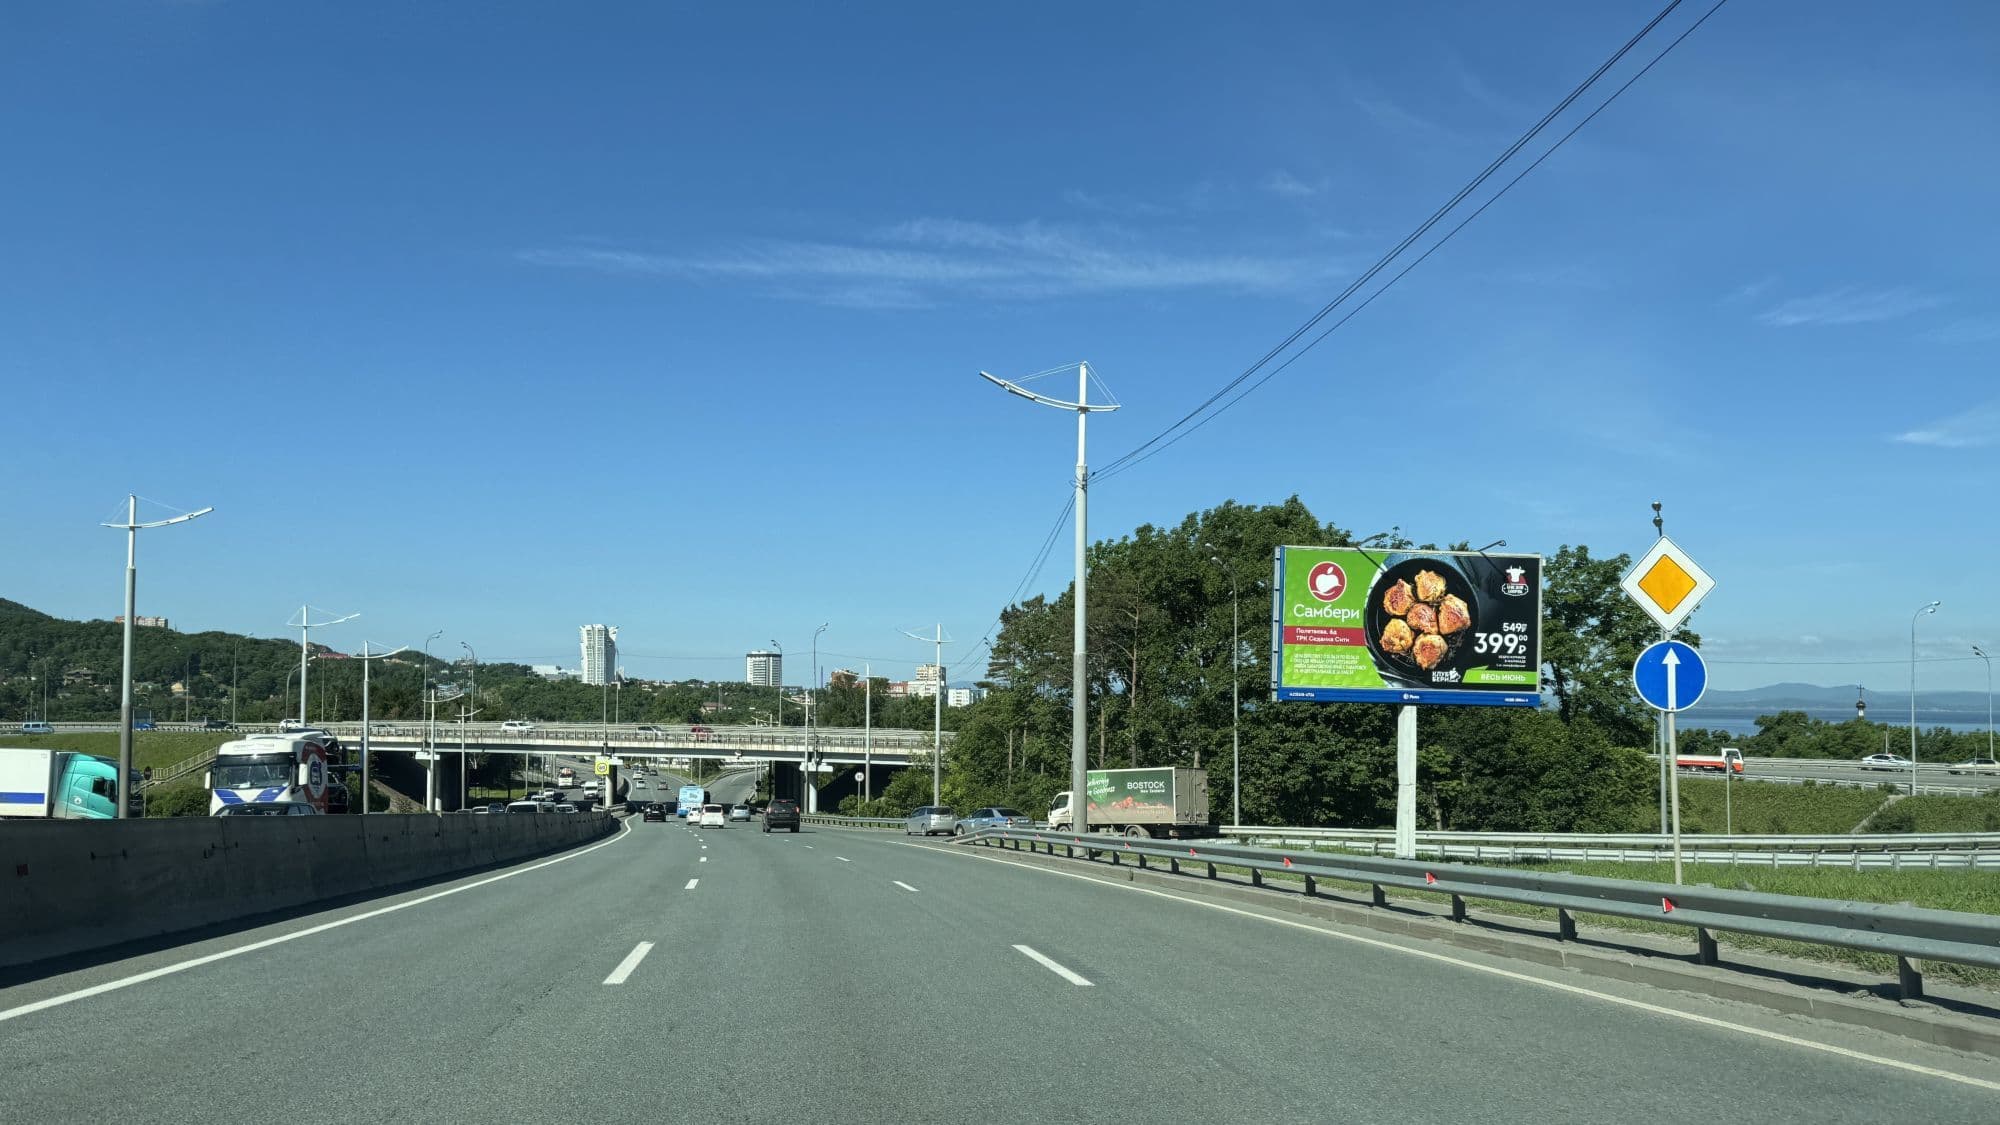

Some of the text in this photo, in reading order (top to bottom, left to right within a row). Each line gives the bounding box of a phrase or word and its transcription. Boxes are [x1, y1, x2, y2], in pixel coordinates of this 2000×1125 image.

[1294, 604, 1360, 622] Самбери
[1474, 633, 1518, 653] 399
[1502, 674, 1526, 682] ИЮНЬ
